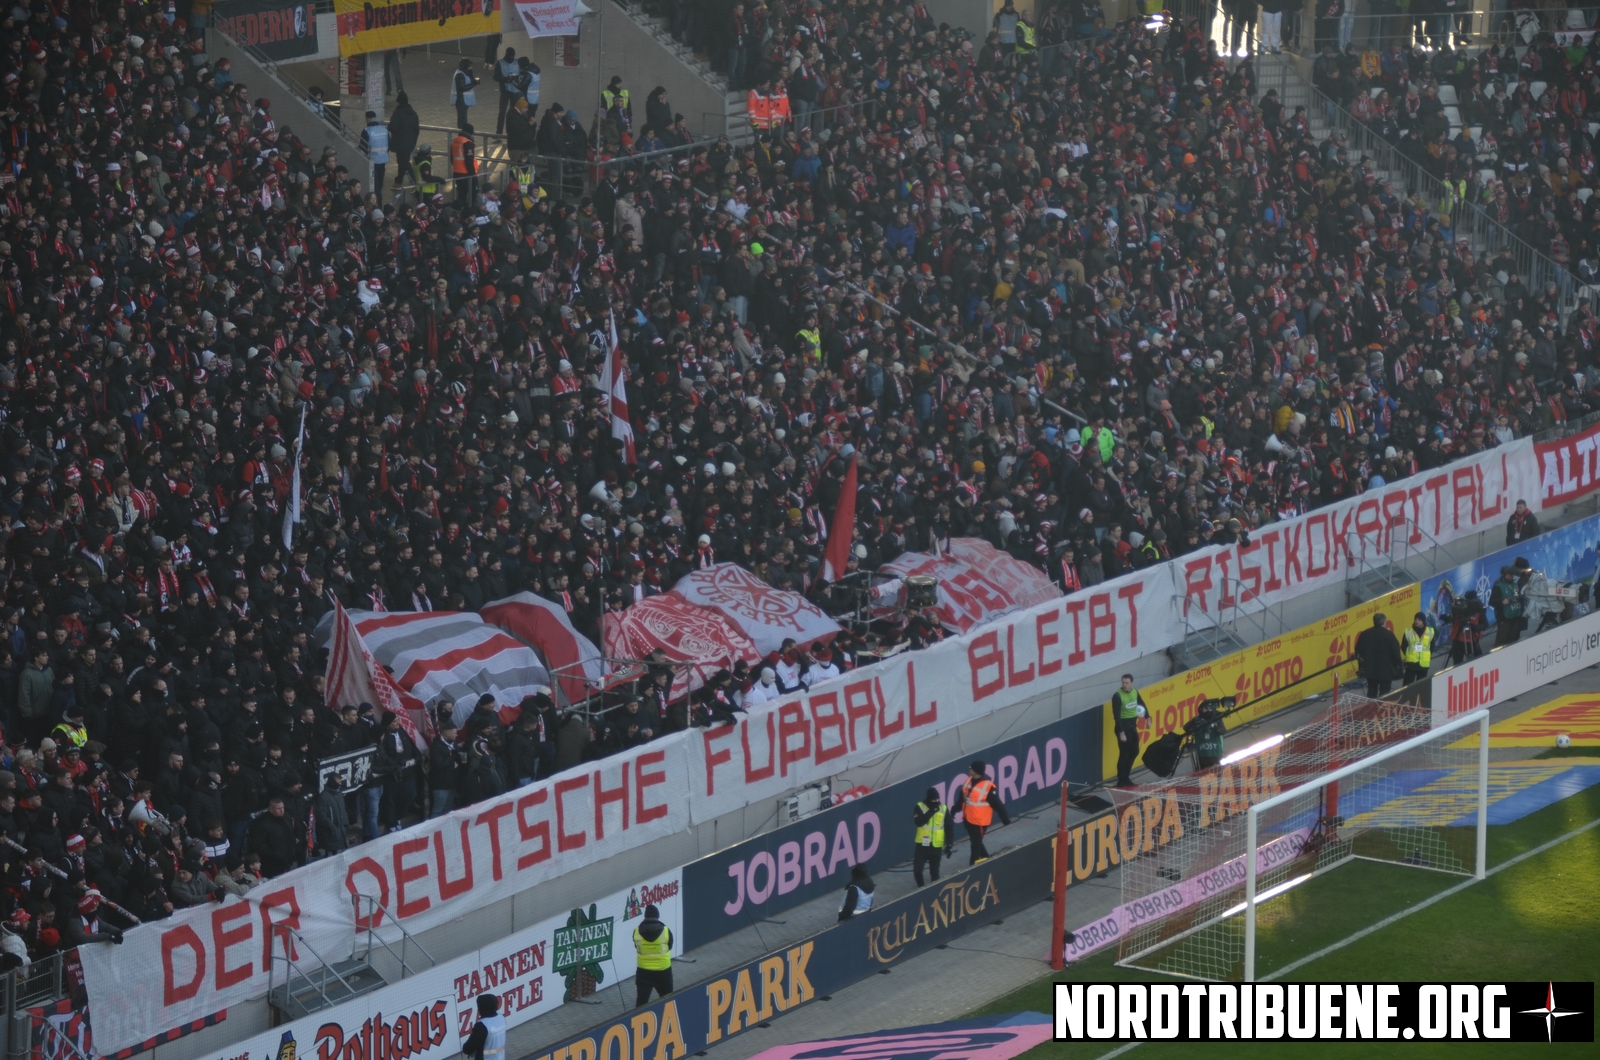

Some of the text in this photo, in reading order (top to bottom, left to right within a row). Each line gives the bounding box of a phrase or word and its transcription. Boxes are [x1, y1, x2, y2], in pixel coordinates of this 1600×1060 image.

[364, 0, 417, 31] Dreisam
[420, 0, 456, 26] Magic
[1396, 589, 1413, 602] LOTTO
[1331, 614, 1348, 627] LOTTO
[1263, 639, 1281, 652] LOTTO
[1526, 638, 1569, 675] Inspired
[1571, 637, 1585, 661] by
[1193, 666, 1211, 682] LOTTO
[1254, 655, 1303, 699] LOTTO
[1447, 667, 1500, 719] huber
[161, 886, 300, 1007] DER
[345, 750, 669, 934] DEUTSCHE
[968, 581, 1145, 702] BLEIBT
[1199, 745, 1281, 829] PARK
[724, 811, 881, 916] JOBRAD
[640, 879, 679, 908] Rothaus
[1069, 833, 1308, 955] JOBRAD JOBRAD JOBRAD JOBRAD
[556, 921, 612, 948] TANNEN
[866, 873, 1001, 964] RULANTICA
[454, 940, 547, 1004] TANNEN
[556, 940, 609, 968] ZÄPFLE
[459, 976, 543, 1038] ZFLE
[706, 941, 815, 1045] PARK
[313, 1000, 448, 1060] Rothaus
